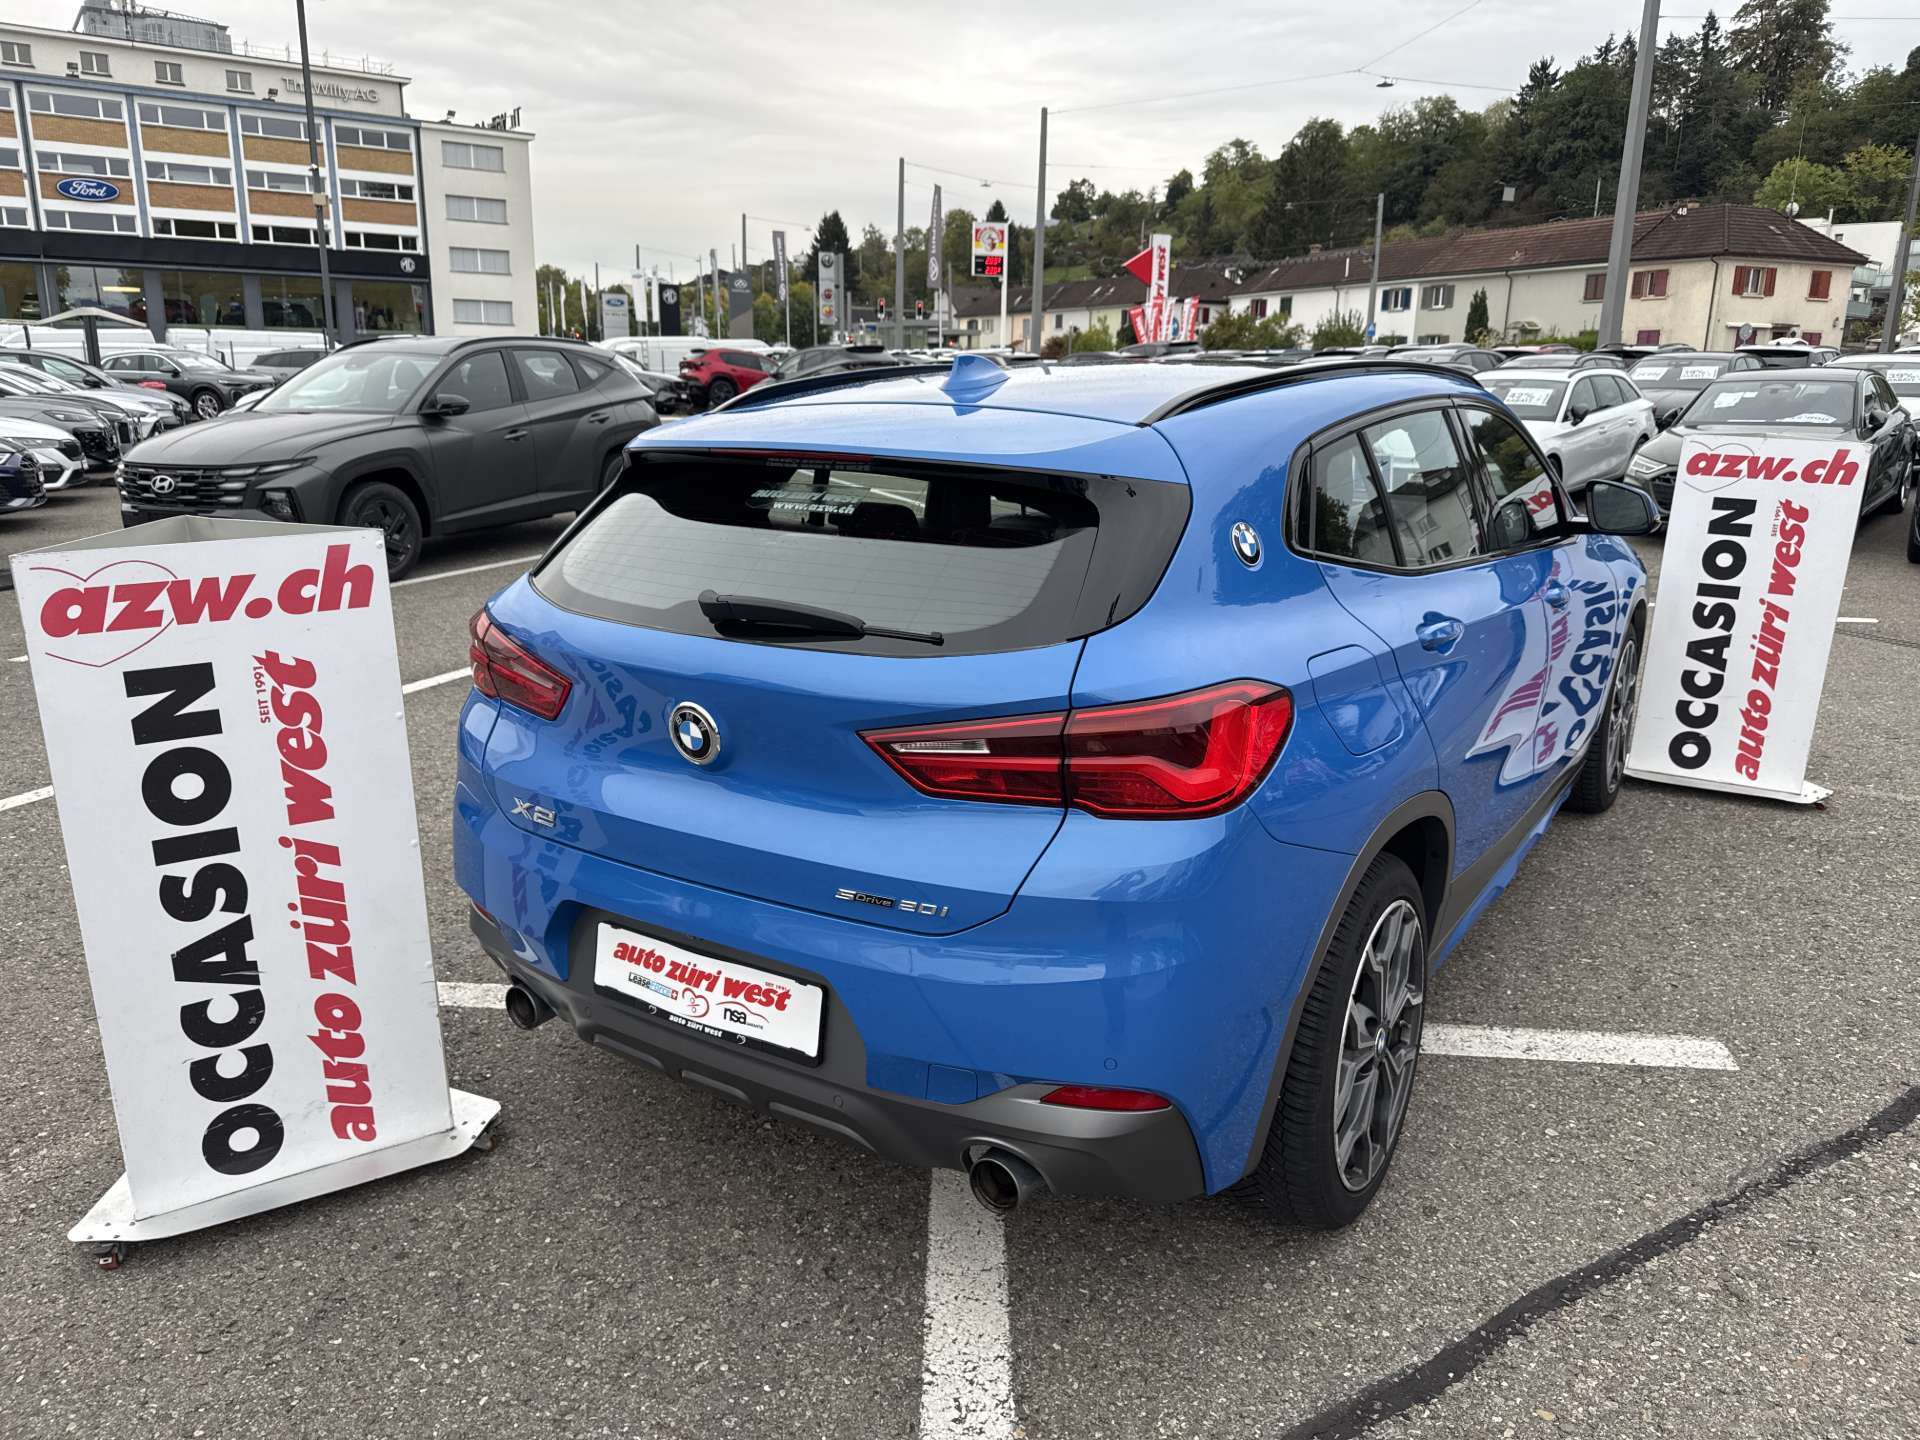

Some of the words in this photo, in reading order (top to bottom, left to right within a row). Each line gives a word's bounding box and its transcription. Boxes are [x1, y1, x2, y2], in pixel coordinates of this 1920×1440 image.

[311, 80, 350, 102] Willy
[354, 87, 379, 103] AG
[69, 180, 108, 197] Ford
[662, 289, 678, 305] MG
[1686, 449, 1859, 485] azw.ch
[773, 501, 855, 515] www.azw.ch
[1768, 498, 1809, 596] west
[40, 543, 375, 638] azw.ch
[1668, 497, 1757, 769] OCCASION
[1750, 598, 1789, 690] züri
[253, 665, 267, 695] 1991
[252, 649, 335, 826] west
[257, 698, 271, 724] SEIT
[1735, 689, 1771, 781] auto
[511, 796, 556, 828] X2
[122, 661, 285, 1176] OCCASION
[277, 835, 356, 985] züri
[613, 942, 666, 973] auto
[665, 960, 722, 992] züri
[723, 977, 791, 1012] west
[668, 1014, 687, 1026] auto
[704, 1025, 723, 1038] west
[723, 1007, 747, 1025] nsa
[306, 992, 376, 1142] auto
